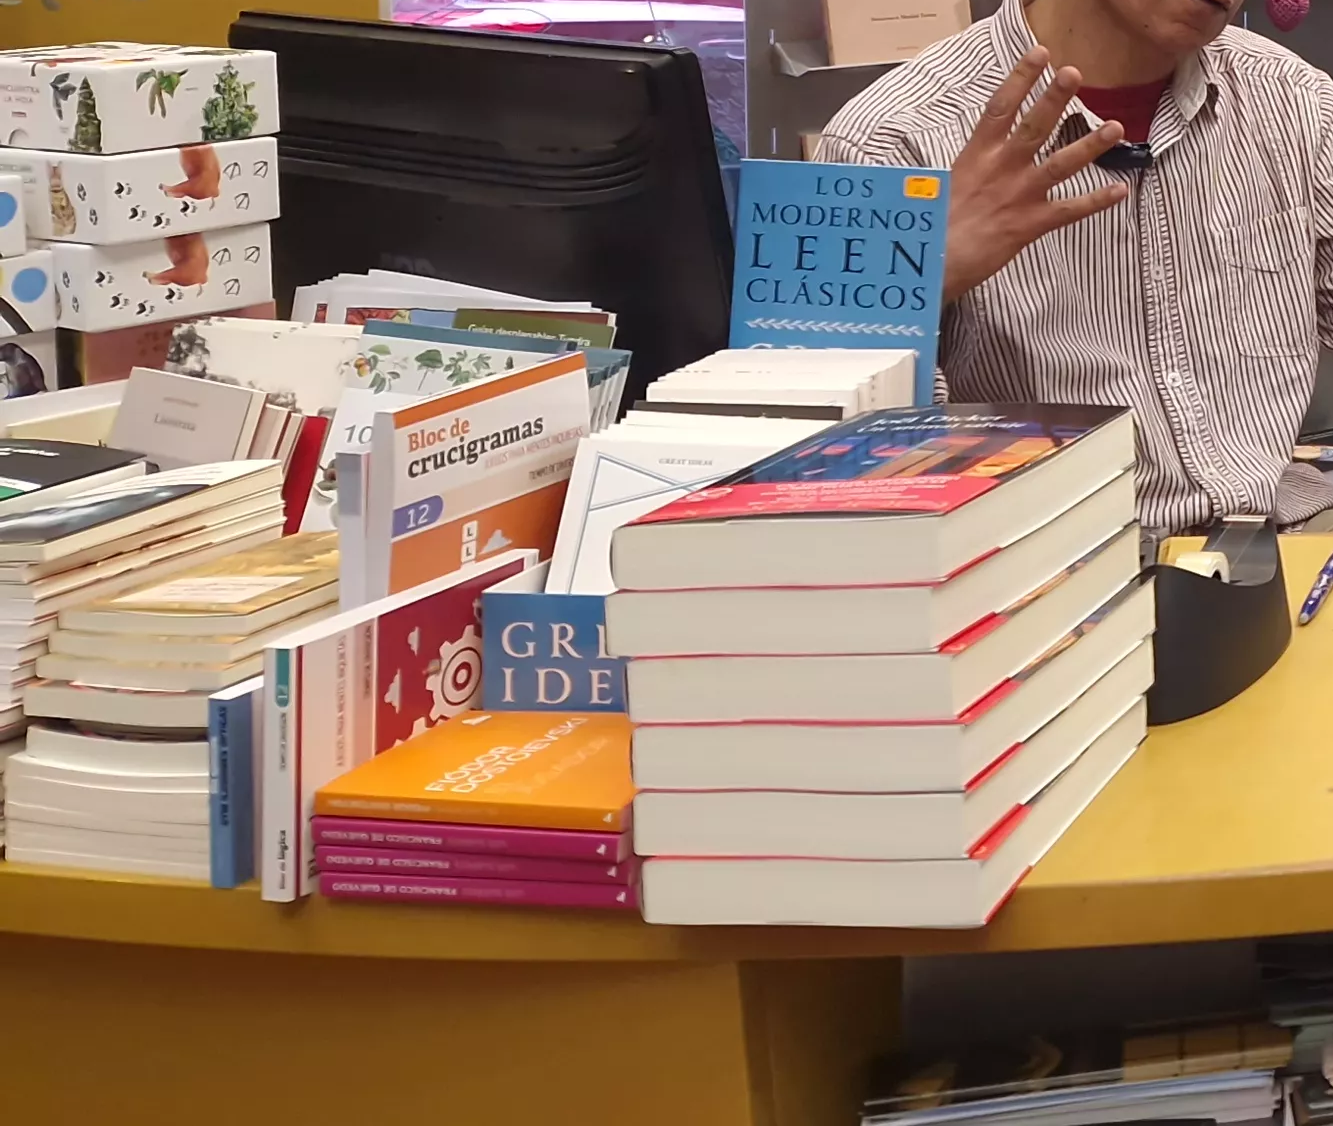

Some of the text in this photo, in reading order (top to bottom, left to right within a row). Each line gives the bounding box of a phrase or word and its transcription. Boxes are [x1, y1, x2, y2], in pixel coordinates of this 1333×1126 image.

[816, 176, 875, 199] LOS
[751, 201, 933, 233] MODERNOS
[750, 232, 930, 278] LEEN
[745, 274, 927, 312] CLÁSICOS
[407, 417, 471, 453] Bloc de
[925, 413, 1006, 427] Dicker
[407, 415, 544, 479] crucigramas
[658, 457, 686, 467] GREAT
[406, 503, 430, 529] 12
[424, 744, 520, 793] FIÓDOR
[449, 717, 590, 793] DOSTOIEVSKI
